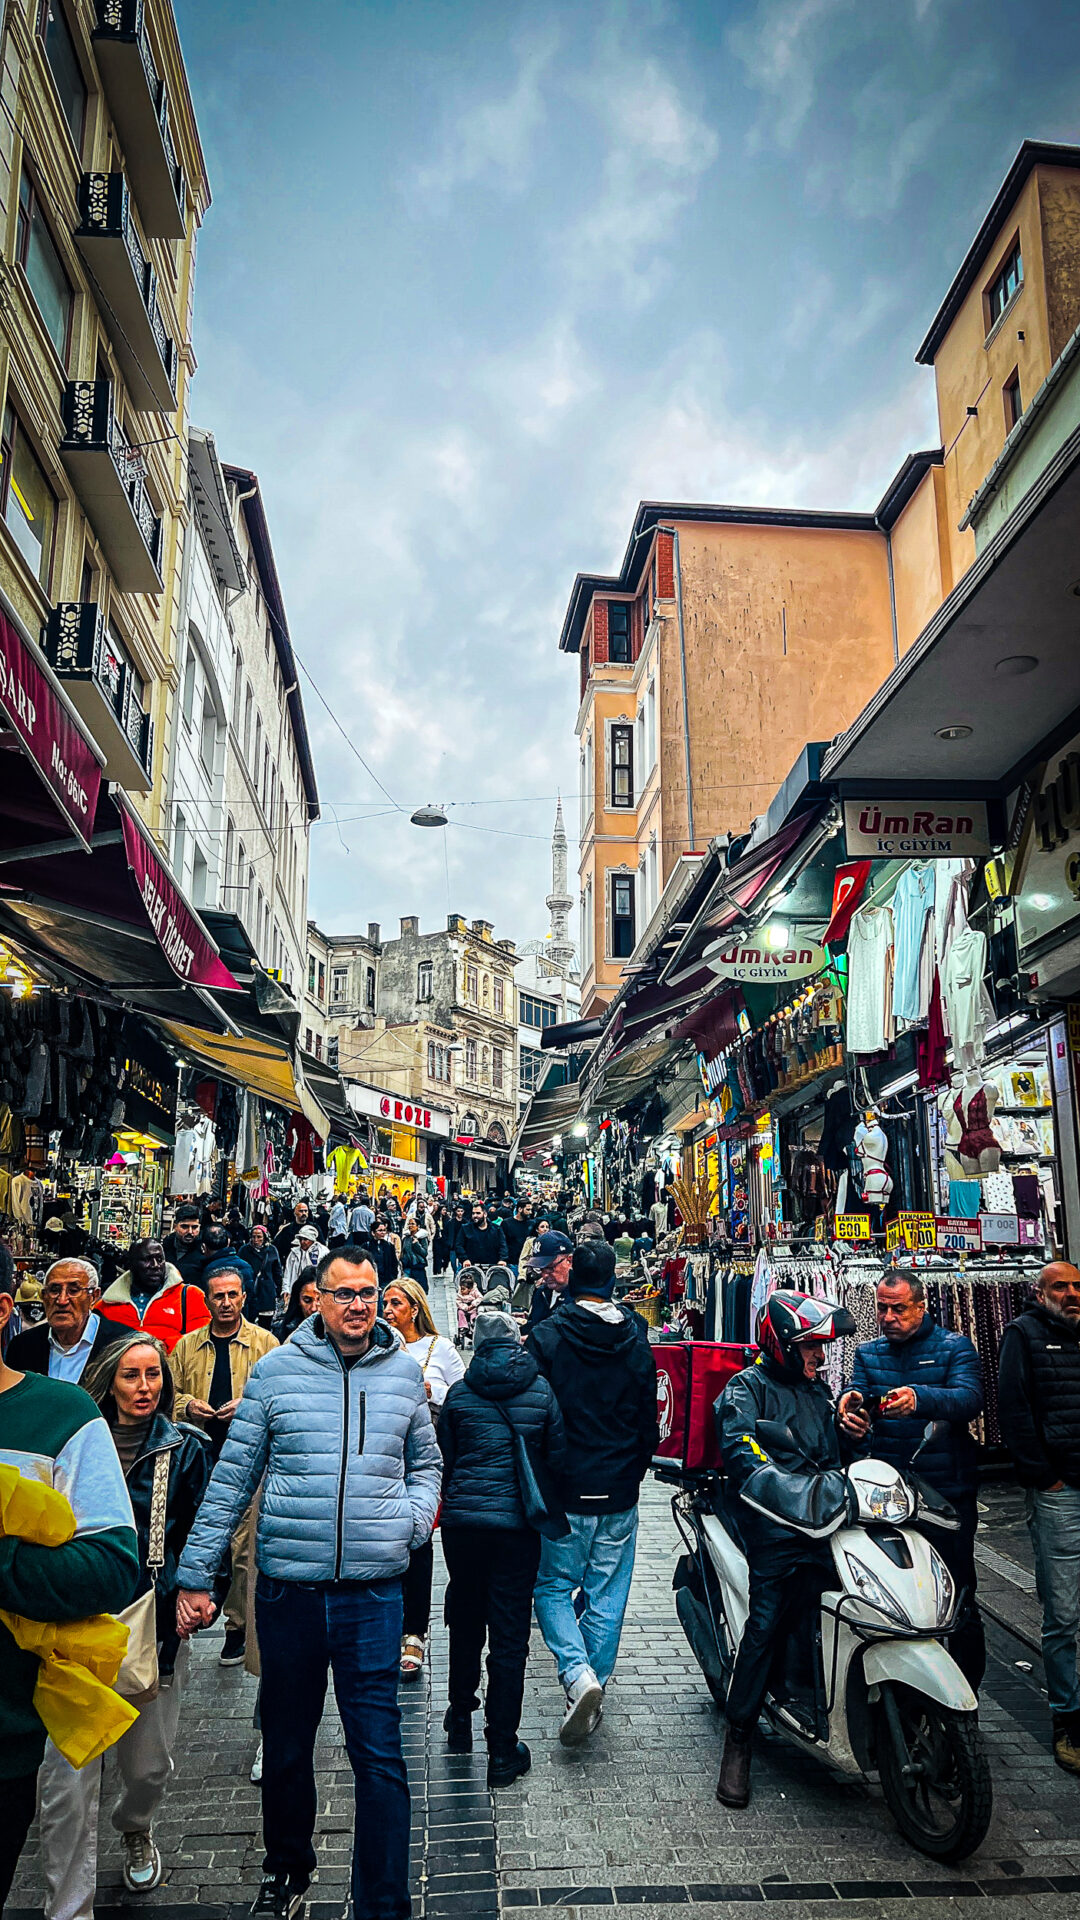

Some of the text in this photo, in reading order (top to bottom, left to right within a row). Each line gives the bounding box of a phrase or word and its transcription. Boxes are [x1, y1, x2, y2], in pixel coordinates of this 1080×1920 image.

[51, 740, 67, 786] No:
[858, 806, 973, 837] ÜmRan
[877, 838, 952, 853] İÇ GİYİM
[162, 914, 195, 977] TİCARET
[733, 966, 788, 979] İÇ GİYİM
[837, 1215, 868, 1223] KAMPANYA
[945, 1234, 966, 1249] 200
